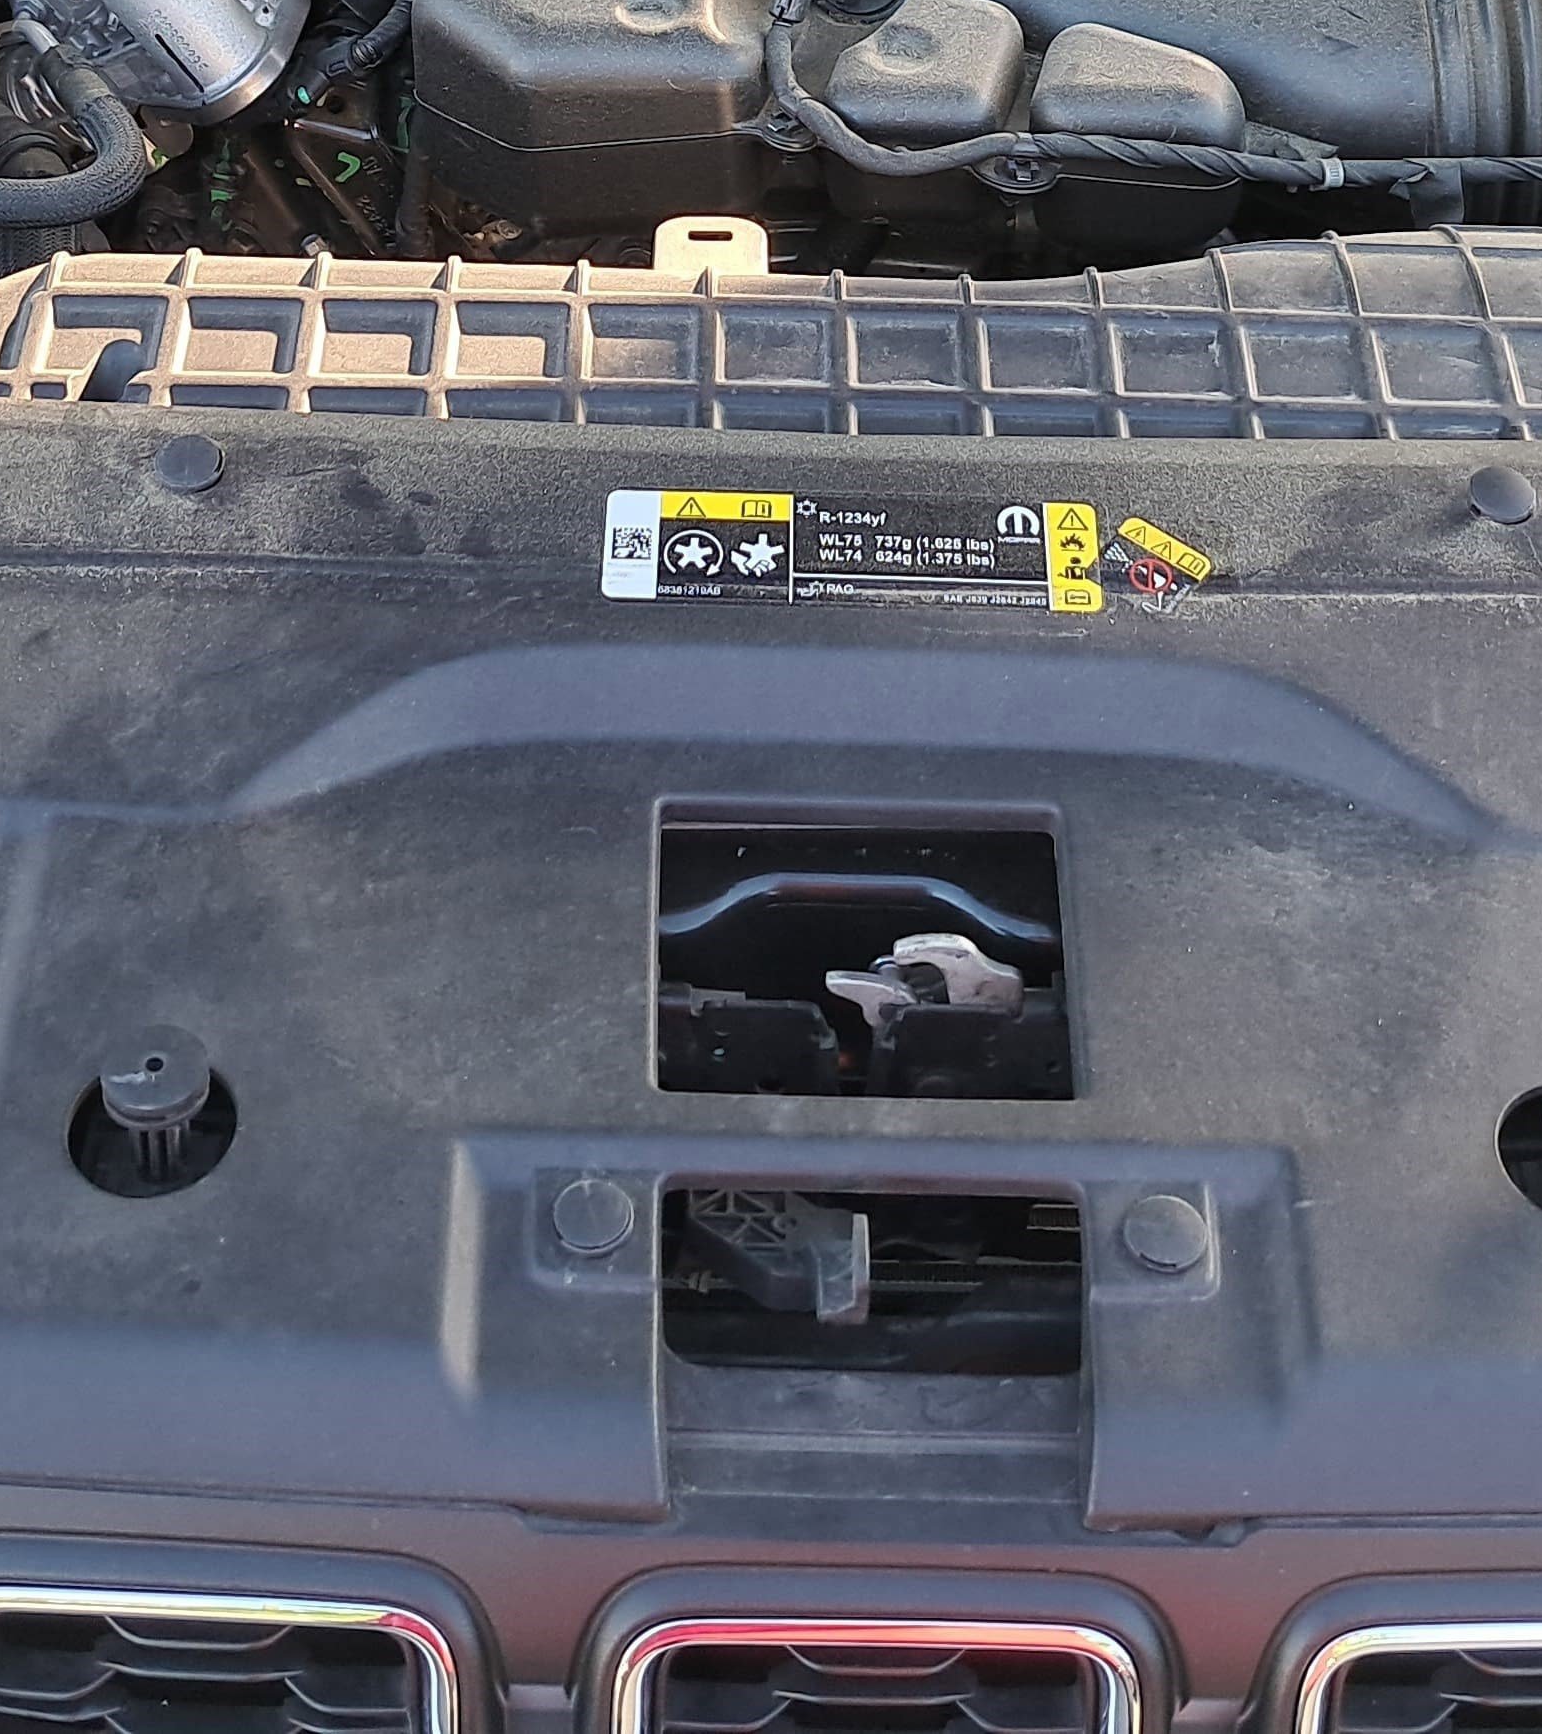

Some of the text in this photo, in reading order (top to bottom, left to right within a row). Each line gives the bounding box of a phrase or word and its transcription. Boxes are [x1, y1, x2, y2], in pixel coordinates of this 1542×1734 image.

[819, 510, 887, 528] R-1234yf
[875, 535, 912, 550] 737g
[966, 537, 995, 553] lbs)
[819, 548, 863, 562] WL74
[875, 550, 912, 566] 624g
[966, 551, 996, 568] lbs)
